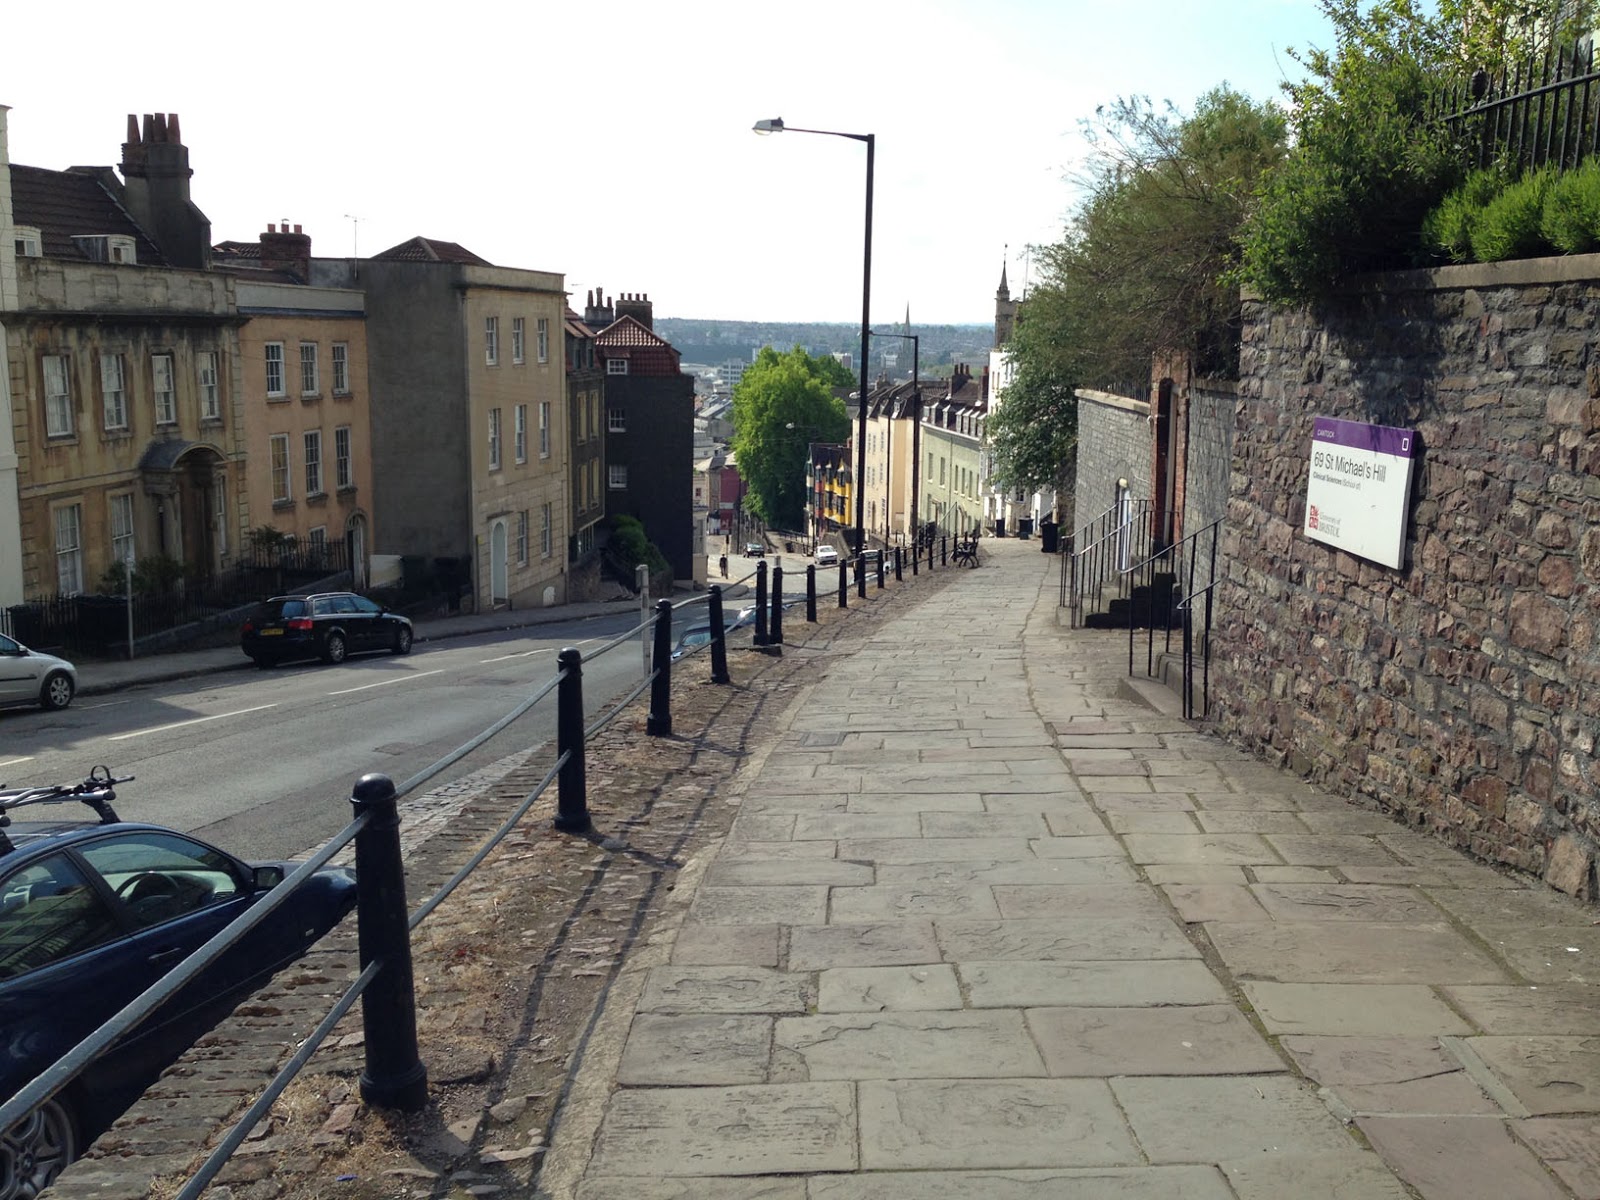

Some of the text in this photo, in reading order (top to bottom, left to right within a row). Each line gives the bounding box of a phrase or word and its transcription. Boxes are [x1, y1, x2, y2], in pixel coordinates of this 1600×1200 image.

[1314, 451, 1387, 483] 69 St Michael's Hill
